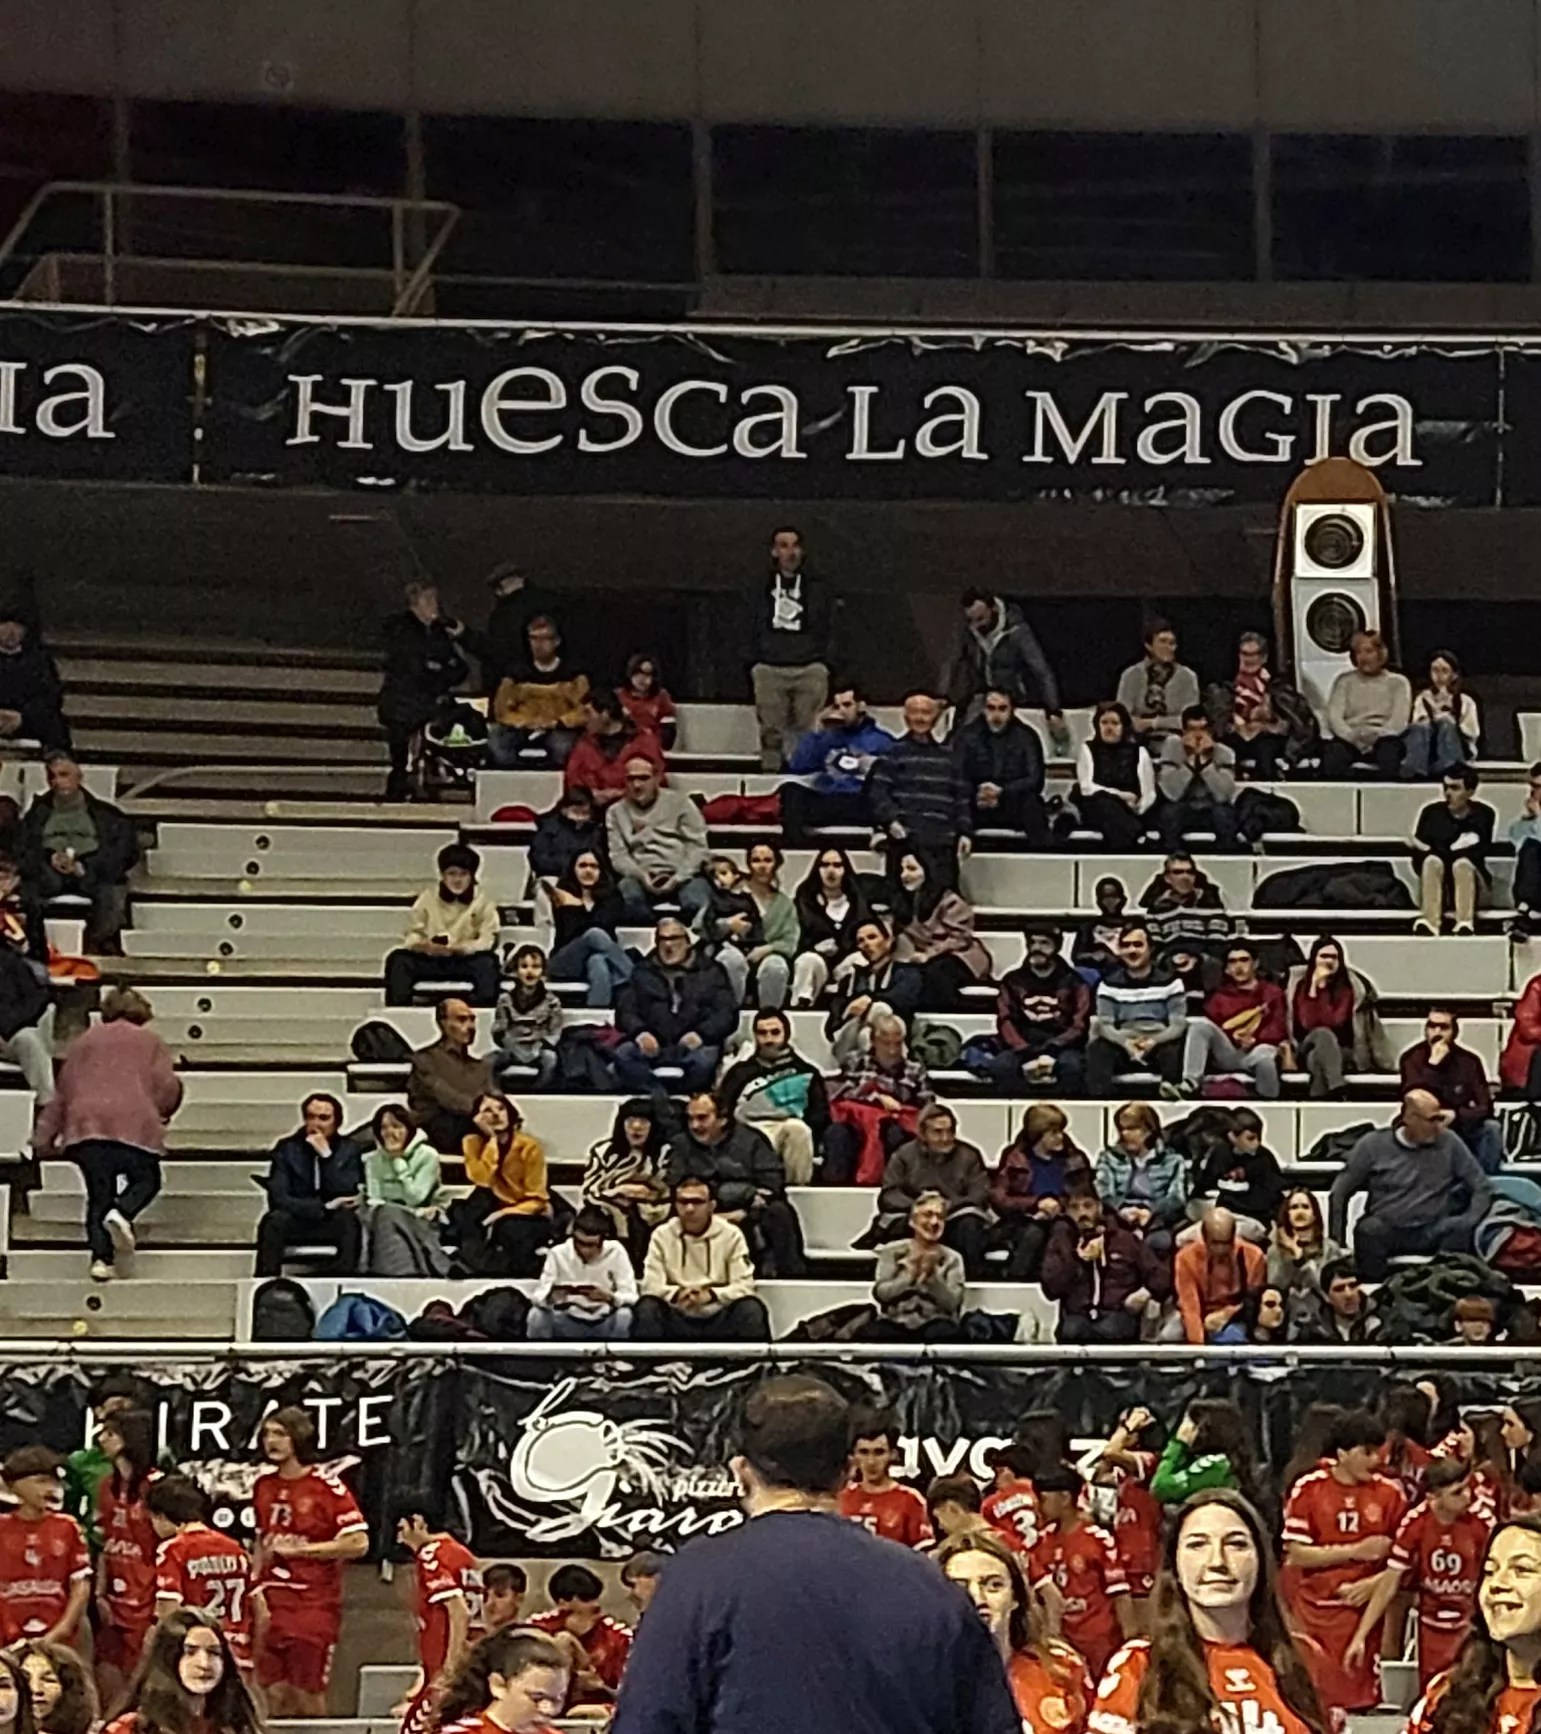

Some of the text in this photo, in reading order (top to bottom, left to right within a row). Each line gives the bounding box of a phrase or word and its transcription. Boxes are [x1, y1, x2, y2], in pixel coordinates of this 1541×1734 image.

[286, 366, 807, 458] Huesca
[1430, 1547, 1463, 1576] 69
[204, 1578, 246, 1621] 27
